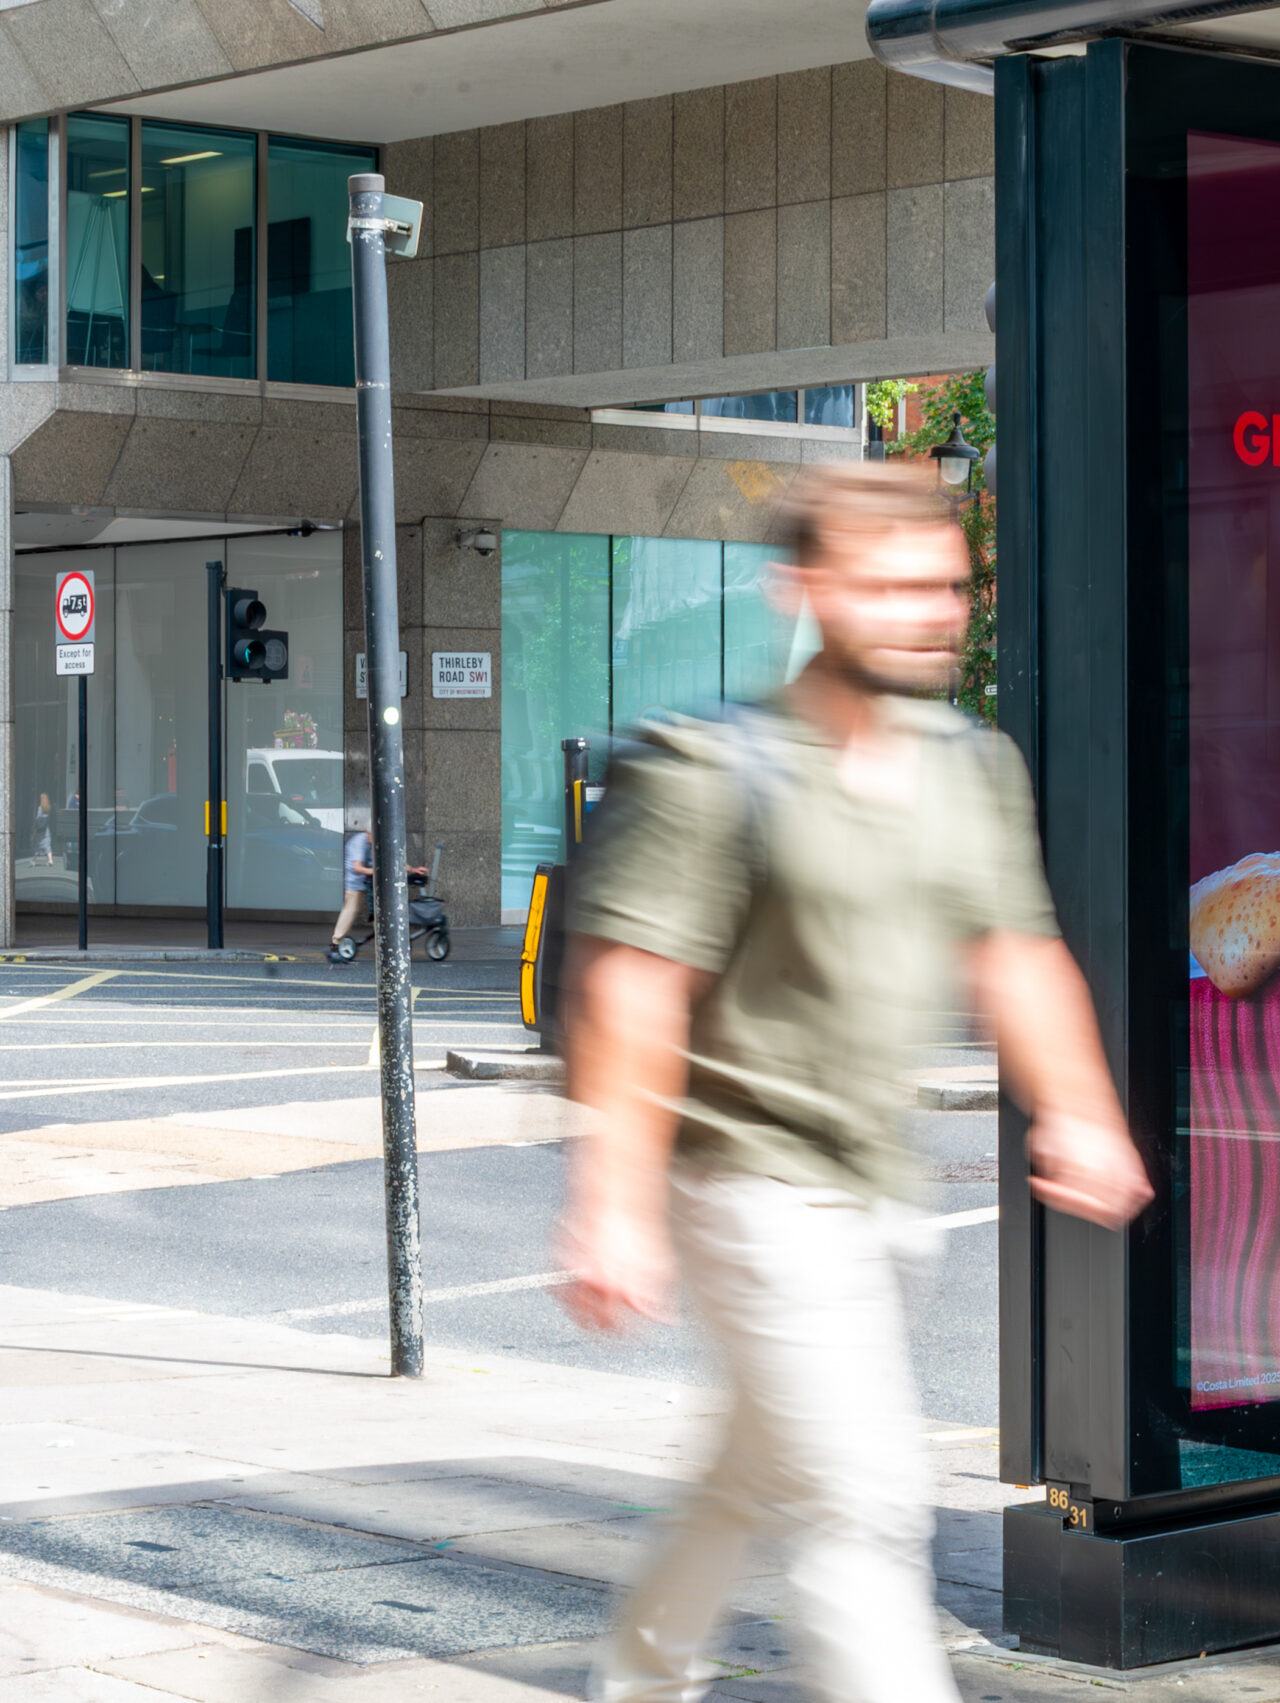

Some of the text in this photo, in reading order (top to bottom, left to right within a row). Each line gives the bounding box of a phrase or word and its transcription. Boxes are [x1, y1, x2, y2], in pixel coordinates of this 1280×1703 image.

[59, 648, 91, 659] Except for
[65, 661, 85, 669] access
[439, 657, 484, 669] THIRLEBY
[439, 671, 488, 682] ROAD SW1
[1228, 1374, 1260, 1389] Limited
[1049, 1488, 1069, 1509] 86
[1070, 1506, 1087, 1528] 31
